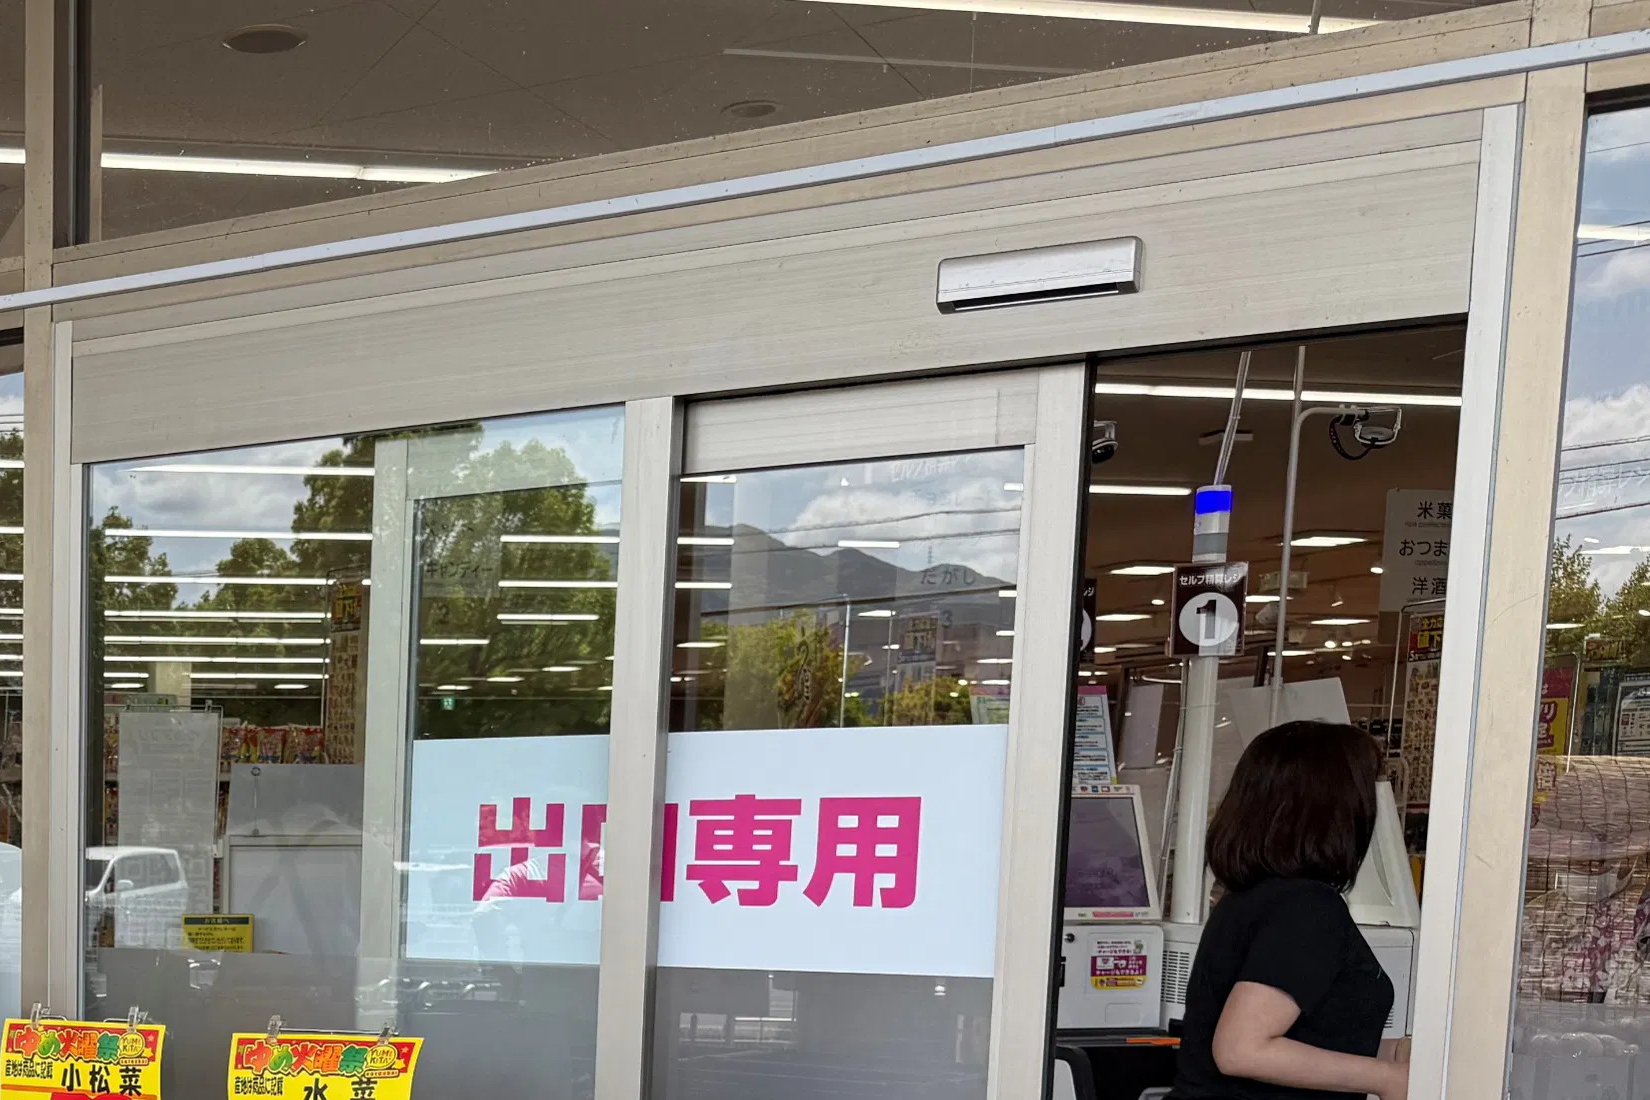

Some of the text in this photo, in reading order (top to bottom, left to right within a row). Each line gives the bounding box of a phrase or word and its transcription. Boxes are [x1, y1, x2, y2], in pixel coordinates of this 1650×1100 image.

[1196, 599, 1218, 640] 1
[14, 1026, 120, 1063] ゆめ火曜祭
[243, 1040, 366, 1077] ゆめ火曜祭
[61, 1063, 142, 1096] 小松菜
